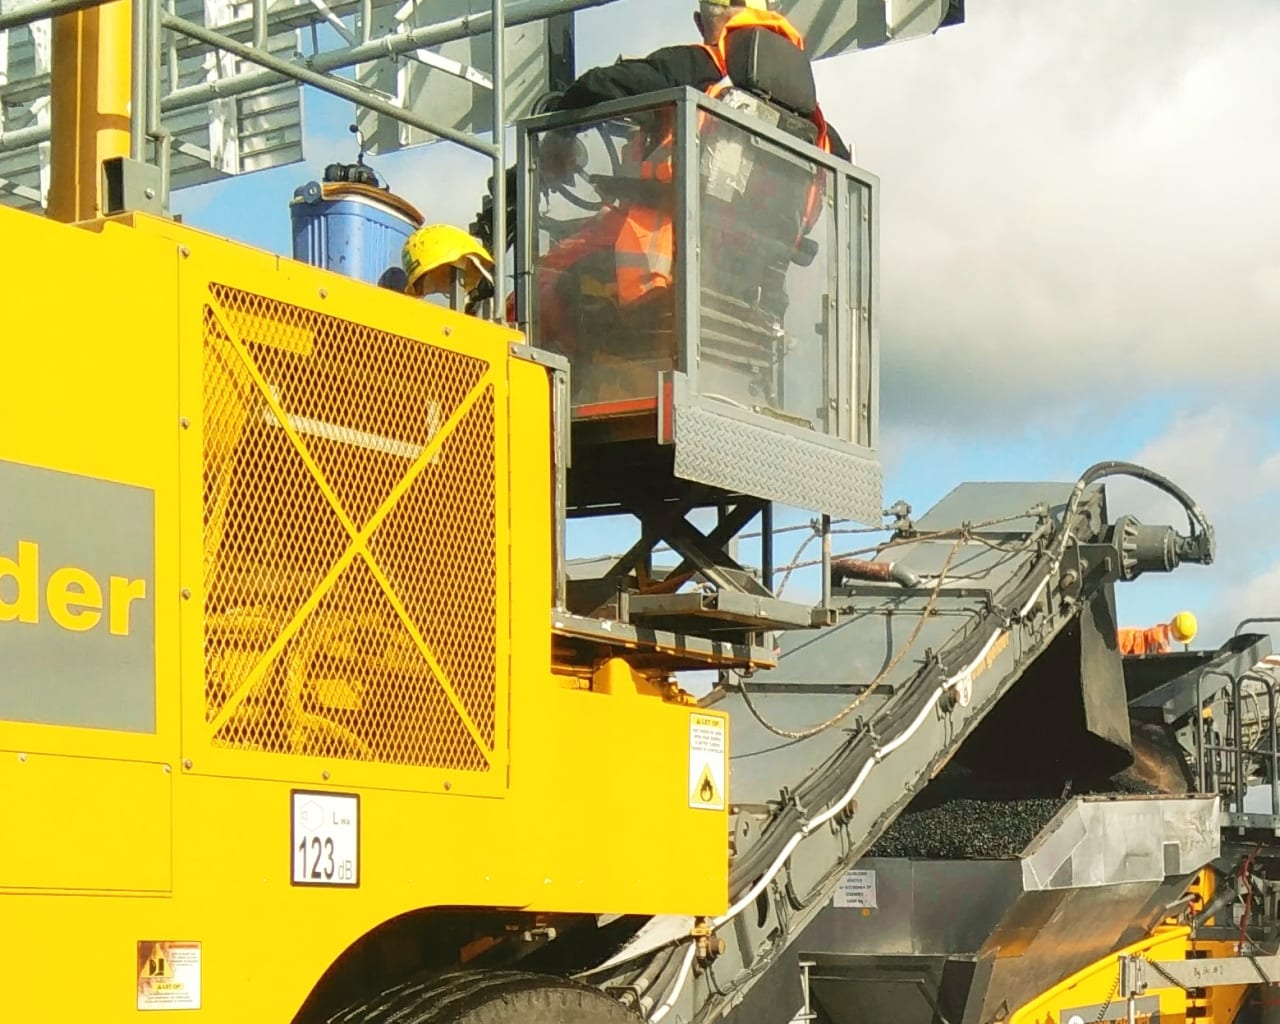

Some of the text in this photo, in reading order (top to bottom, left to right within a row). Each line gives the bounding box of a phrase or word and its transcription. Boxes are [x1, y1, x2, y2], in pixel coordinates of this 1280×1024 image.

[0, 540, 146, 636] der
[299, 835, 352, 880] 123 dB
